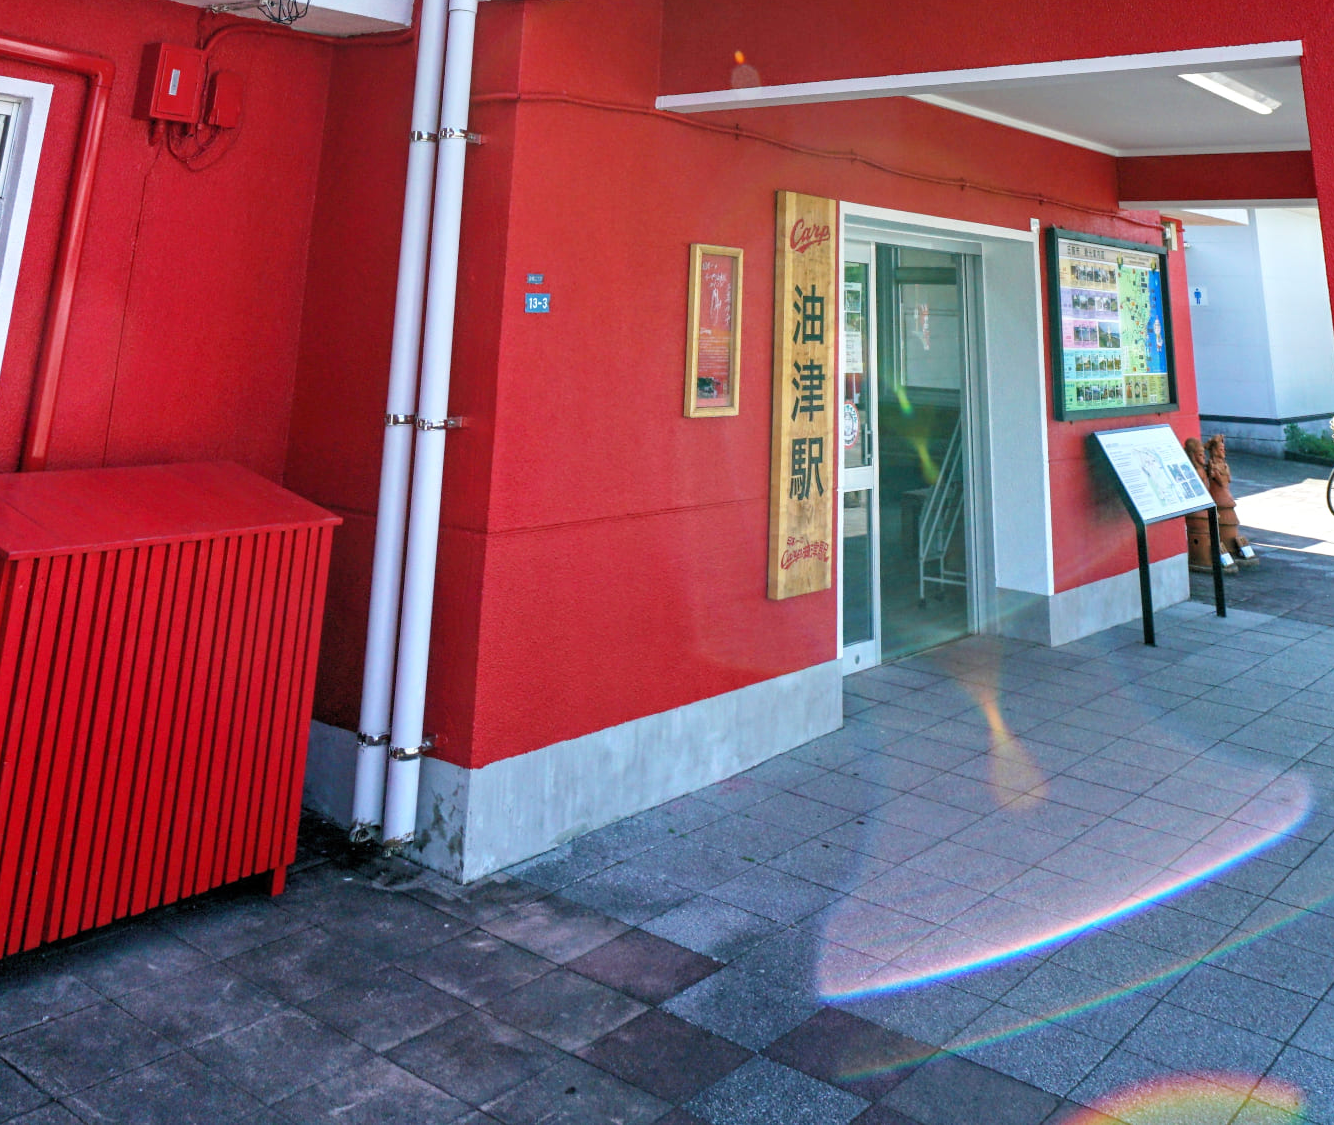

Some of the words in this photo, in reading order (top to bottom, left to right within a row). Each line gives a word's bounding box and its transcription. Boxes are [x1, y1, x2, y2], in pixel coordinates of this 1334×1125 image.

[789, 218, 831, 254] Carp
[528, 297, 548, 310] 13-3
[788, 283, 826, 501] 油津駅
